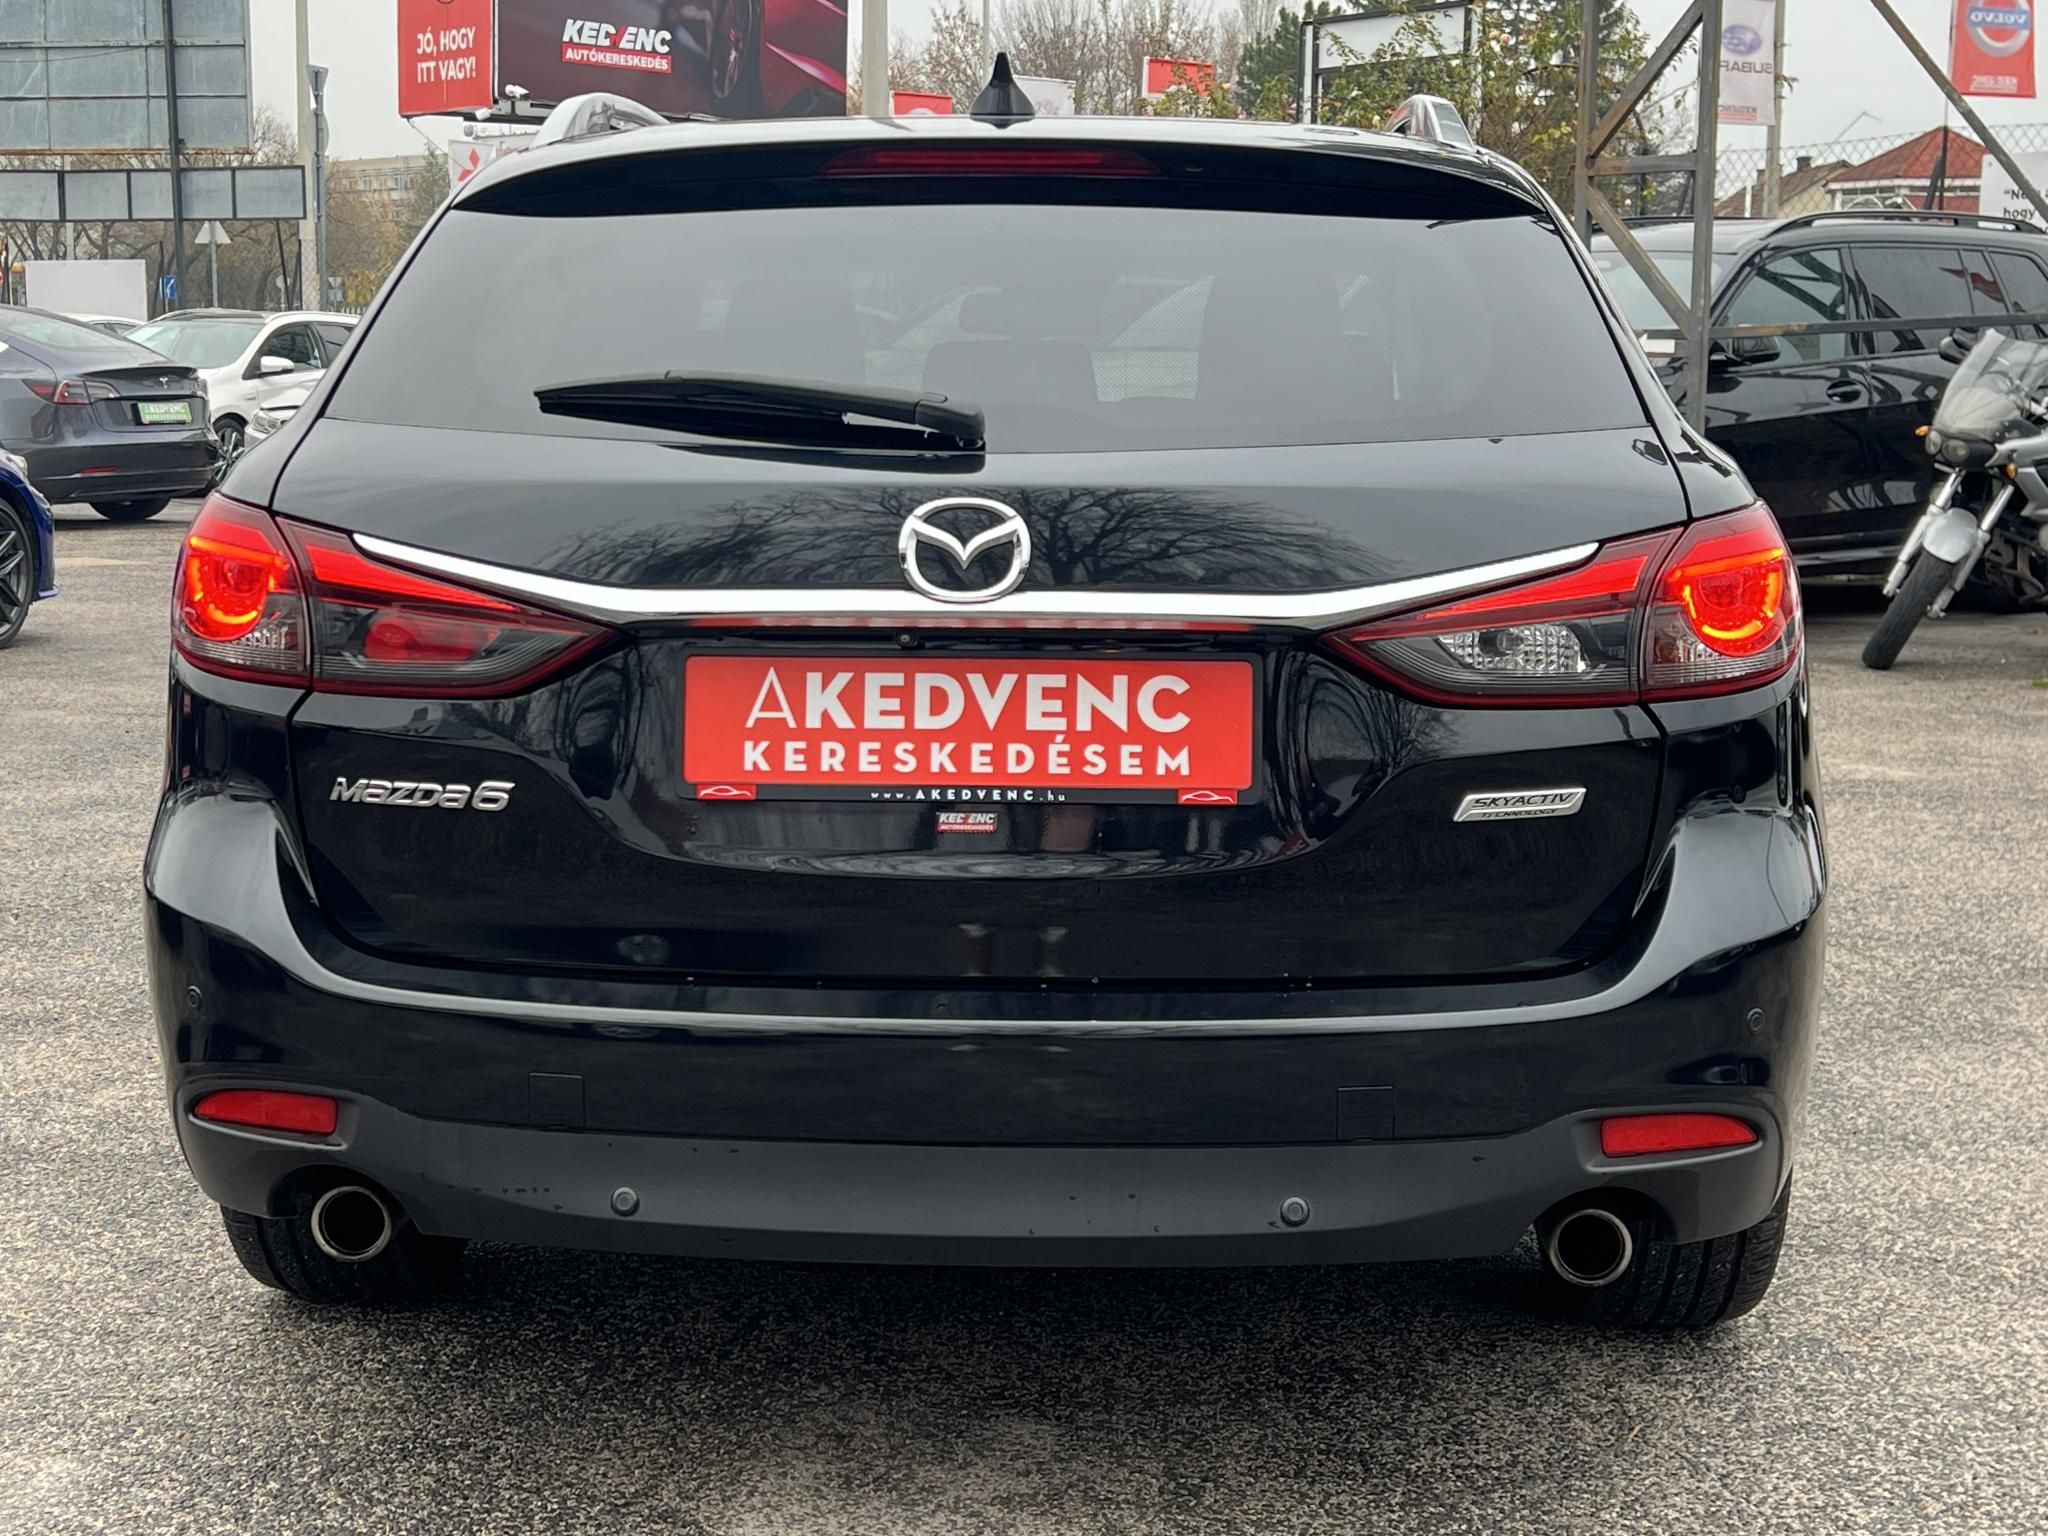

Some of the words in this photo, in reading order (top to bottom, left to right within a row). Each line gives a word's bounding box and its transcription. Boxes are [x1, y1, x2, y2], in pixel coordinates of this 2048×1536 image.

[416, 26, 437, 57] JÓ,
[440, 26, 476, 52] HOGY
[417, 61, 437, 84] ITT
[438, 56, 476, 81] VAGY!
[565, 47, 669, 70] AUTÓKERESKEDÉS
[745, 666, 1191, 733] AKEDVENC
[744, 734, 1190, 776] KERESKEDÉSEM
[870, 789, 1066, 802] www.AKEDVENC.hu
[1471, 793, 1575, 808] SKYACTIV
